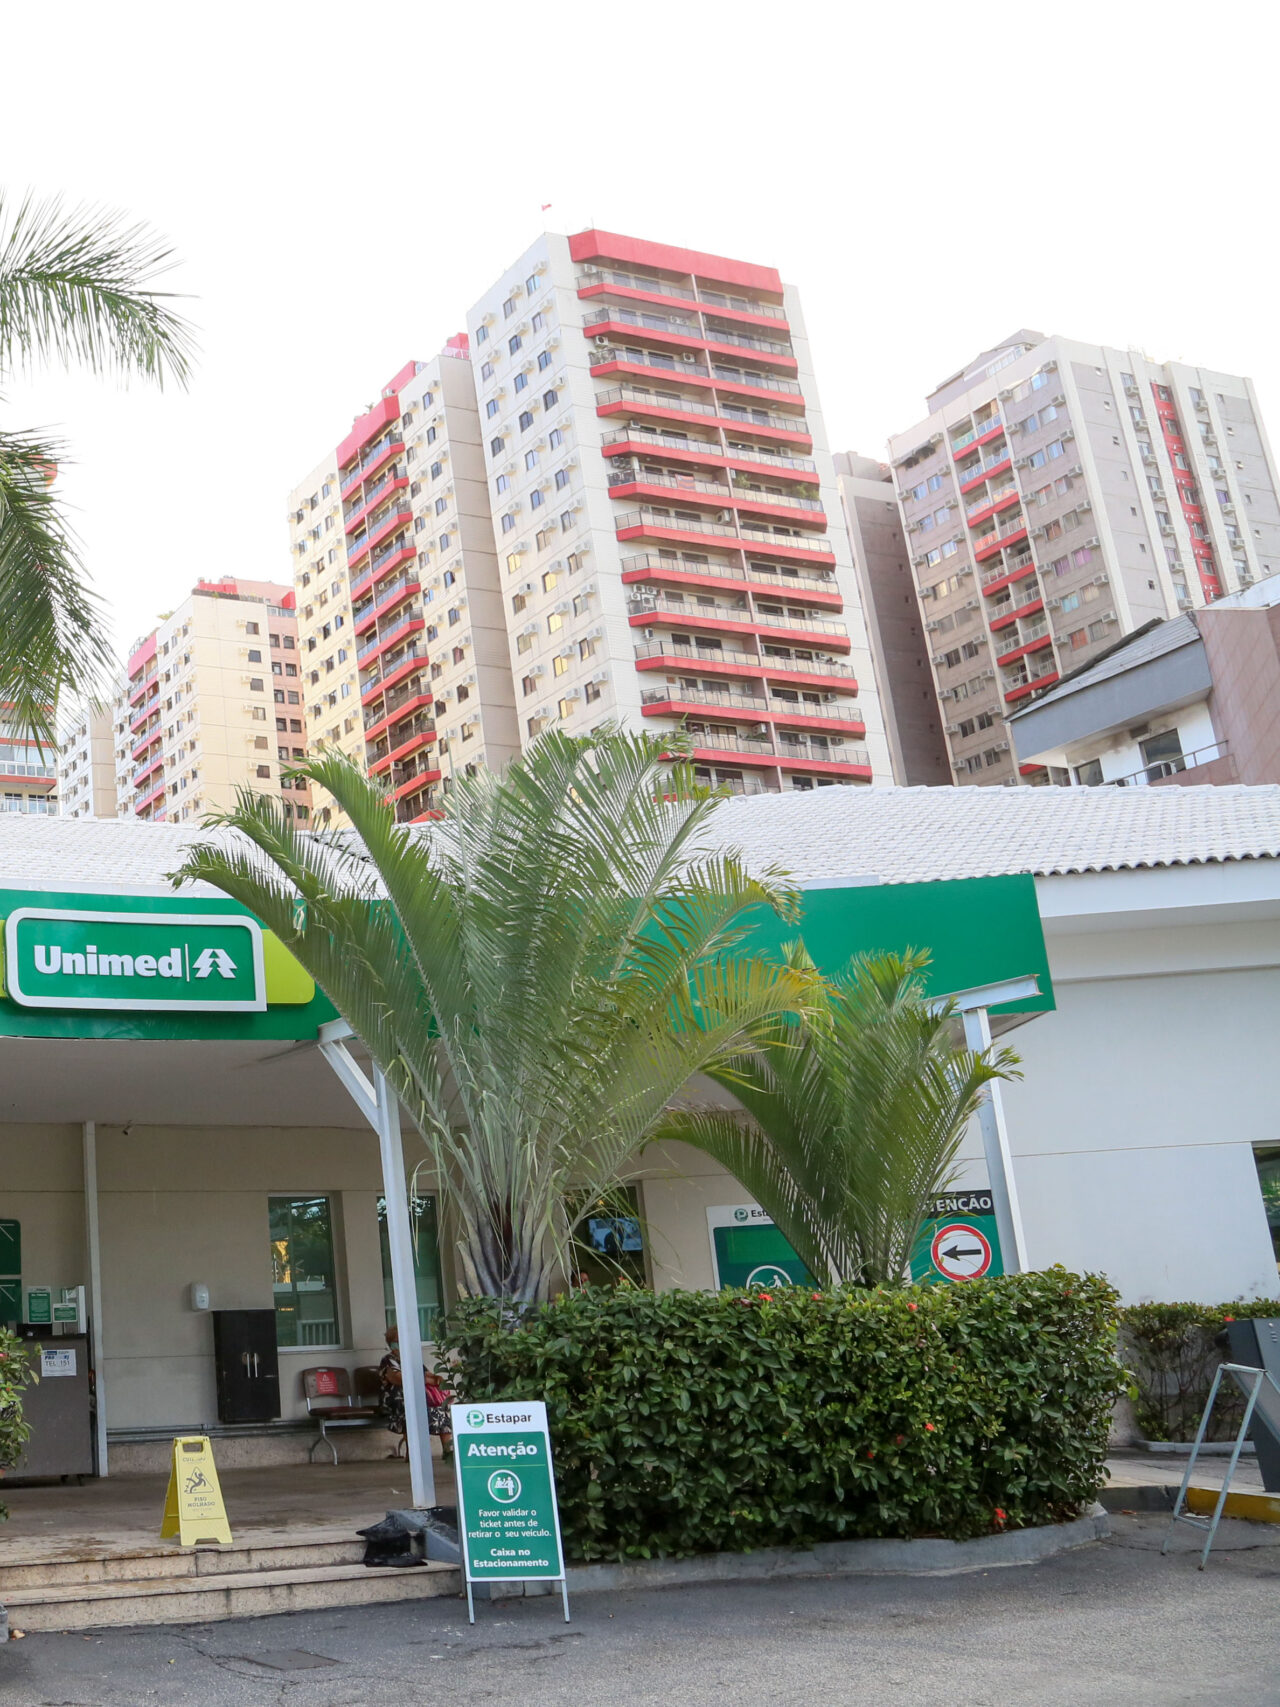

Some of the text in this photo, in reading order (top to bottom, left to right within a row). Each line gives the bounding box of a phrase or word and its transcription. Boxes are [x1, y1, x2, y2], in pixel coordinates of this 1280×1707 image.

[34, 944, 183, 978] Unimed
[486, 1413, 532, 1424] Estapar
[468, 1442, 538, 1459] Atenção
[478, 1509, 500, 1517] Favor
[502, 1508, 529, 1517] validar
[480, 1519, 538, 1528] ticket antes de
[468, 1530, 493, 1538] retirar
[521, 1529, 552, 1538] veículo.
[490, 1548, 516, 1557] Caixa
[473, 1558, 549, 1568] Estacionamento
